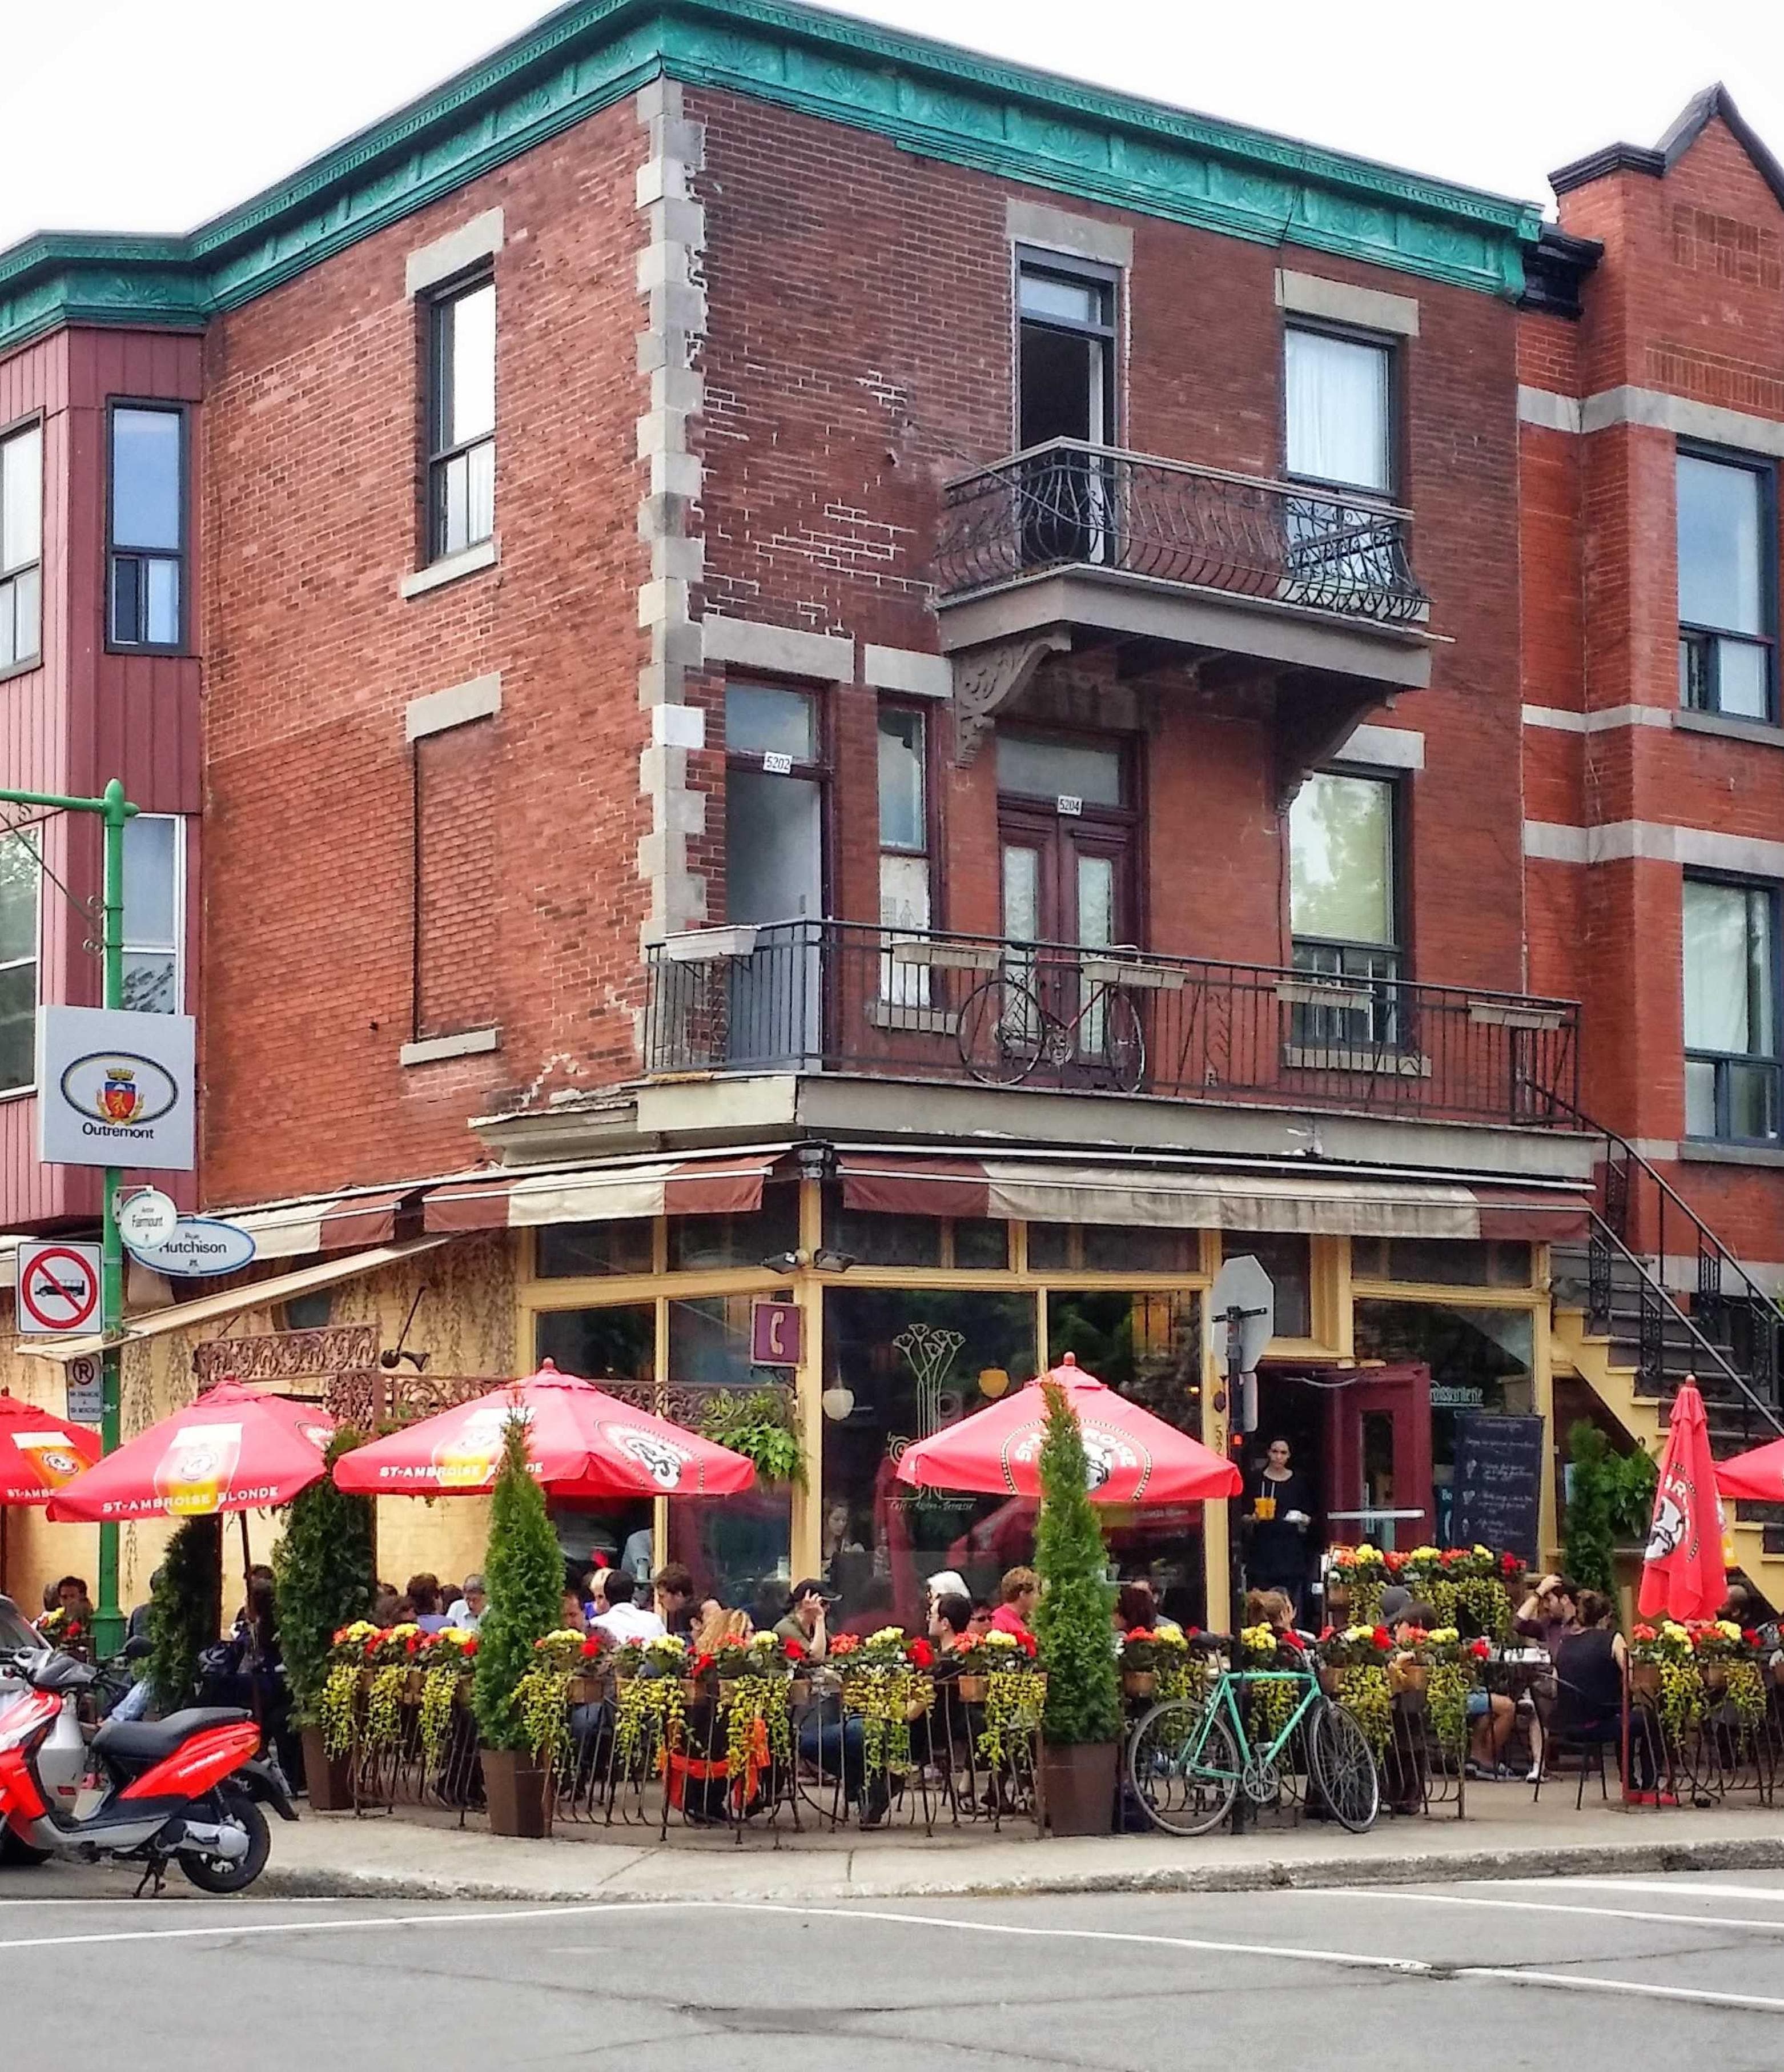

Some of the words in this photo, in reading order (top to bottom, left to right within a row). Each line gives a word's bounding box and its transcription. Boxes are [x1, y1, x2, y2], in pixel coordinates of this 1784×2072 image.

[766, 755, 790, 770] 5202
[1059, 798, 1079, 812] 5204
[82, 1121, 154, 1139] Outremont
[159, 1240, 227, 1254] Hutchison
[380, 1465, 480, 1478] ST-AMBROISE
[102, 1493, 211, 1513] ST-AMBROISE
[218, 1486, 279, 1503] BLONDE
